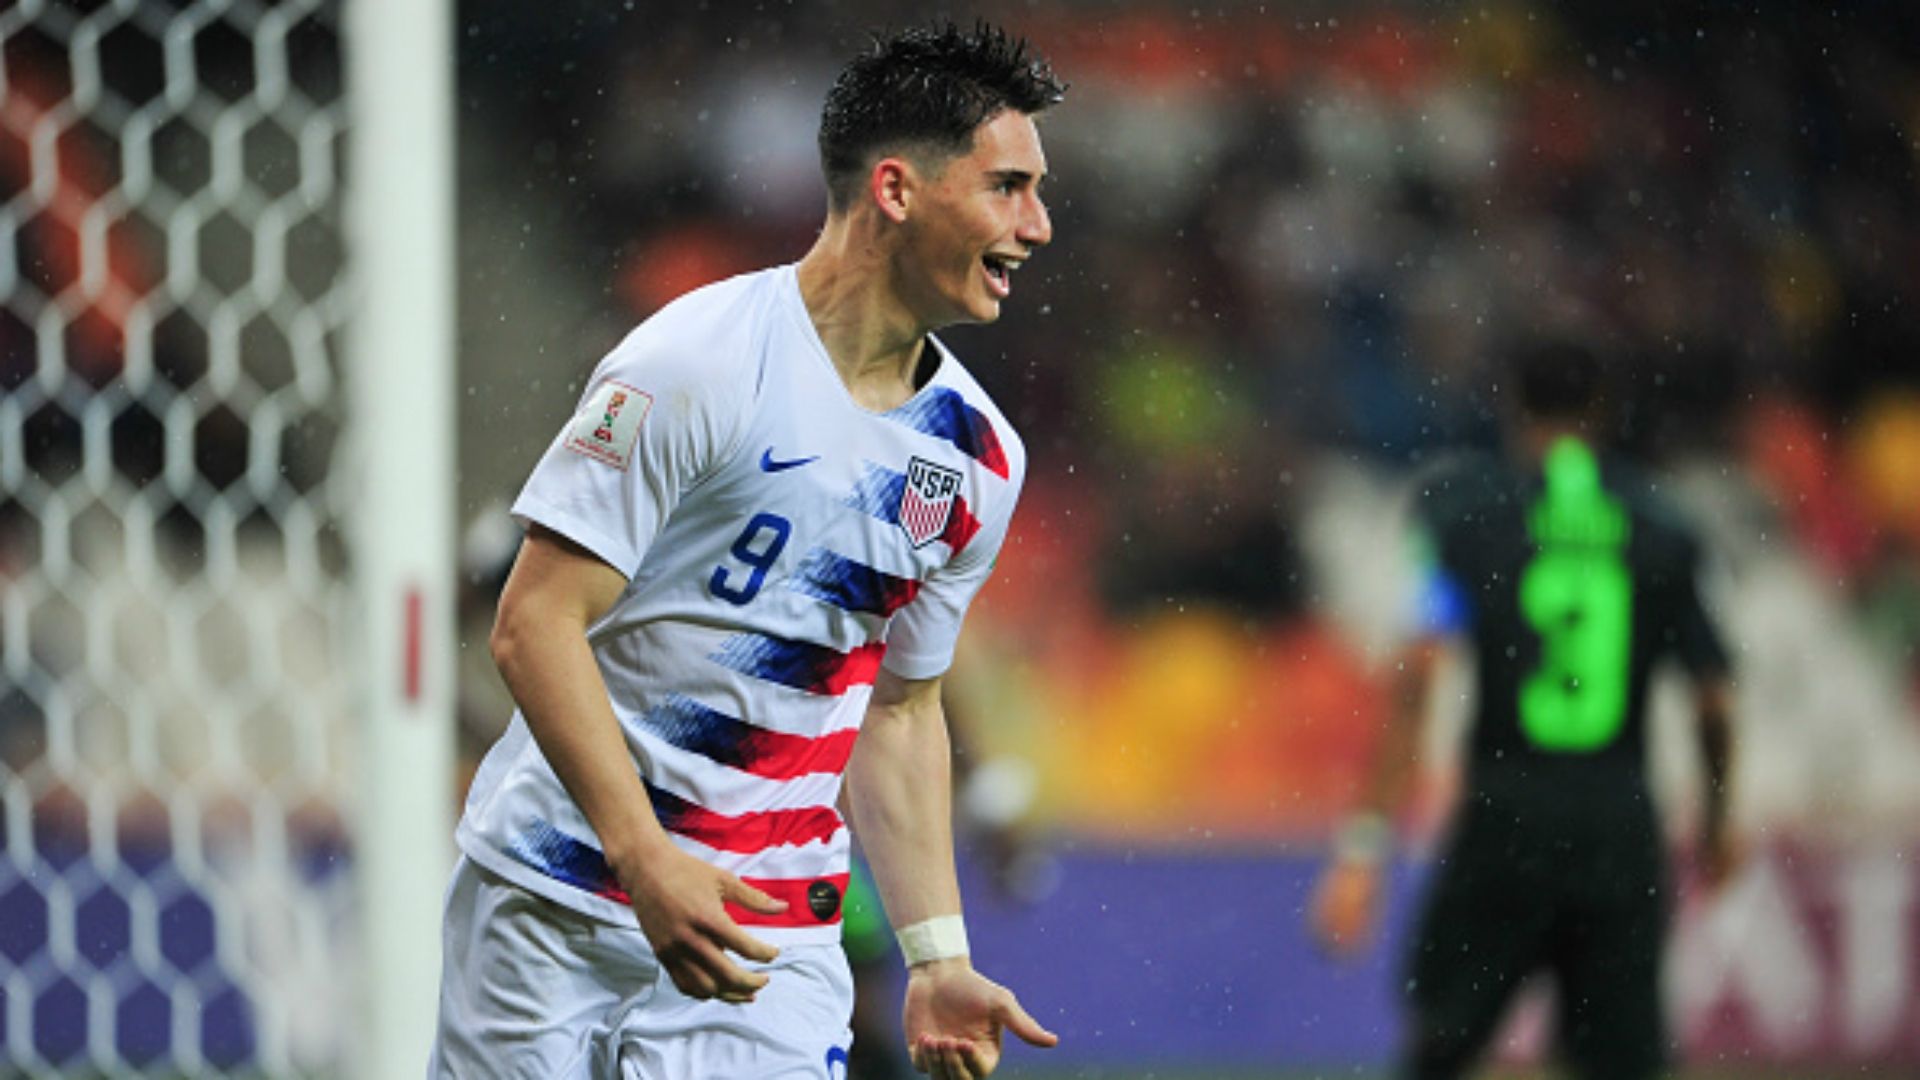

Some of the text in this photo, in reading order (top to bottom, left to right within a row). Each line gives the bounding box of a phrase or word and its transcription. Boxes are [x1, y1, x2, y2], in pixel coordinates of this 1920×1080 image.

[911, 464, 955, 498] USA
[707, 511, 793, 607] 9
[1518, 552, 1632, 750] 3
